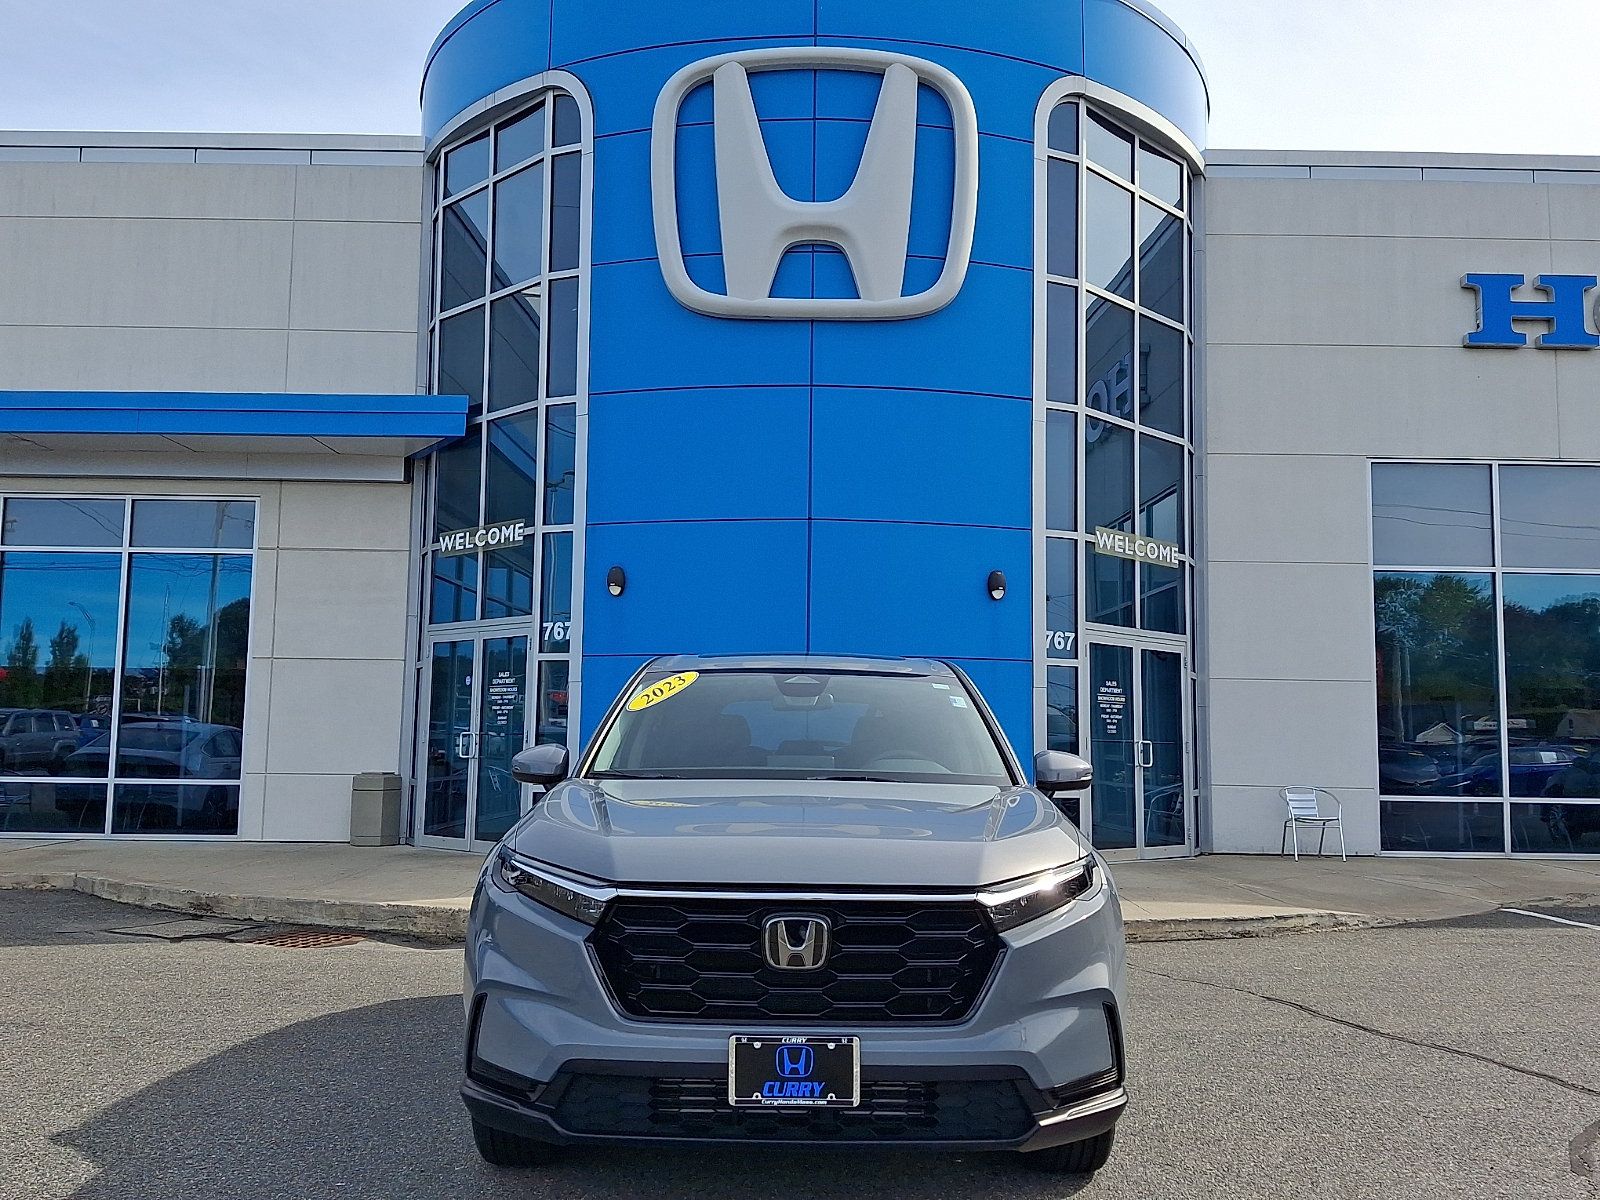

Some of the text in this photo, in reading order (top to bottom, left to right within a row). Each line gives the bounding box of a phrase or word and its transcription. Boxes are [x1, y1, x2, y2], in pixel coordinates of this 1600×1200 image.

[1460, 271, 1600, 350] H
[439, 522, 525, 553] WELCOME
[1096, 530, 1179, 565] WELCOME
[543, 621, 572, 641] 767
[1045, 630, 1075, 651] 767
[640, 676, 686, 706] 2023
[762, 1081, 826, 1097] CURRY
